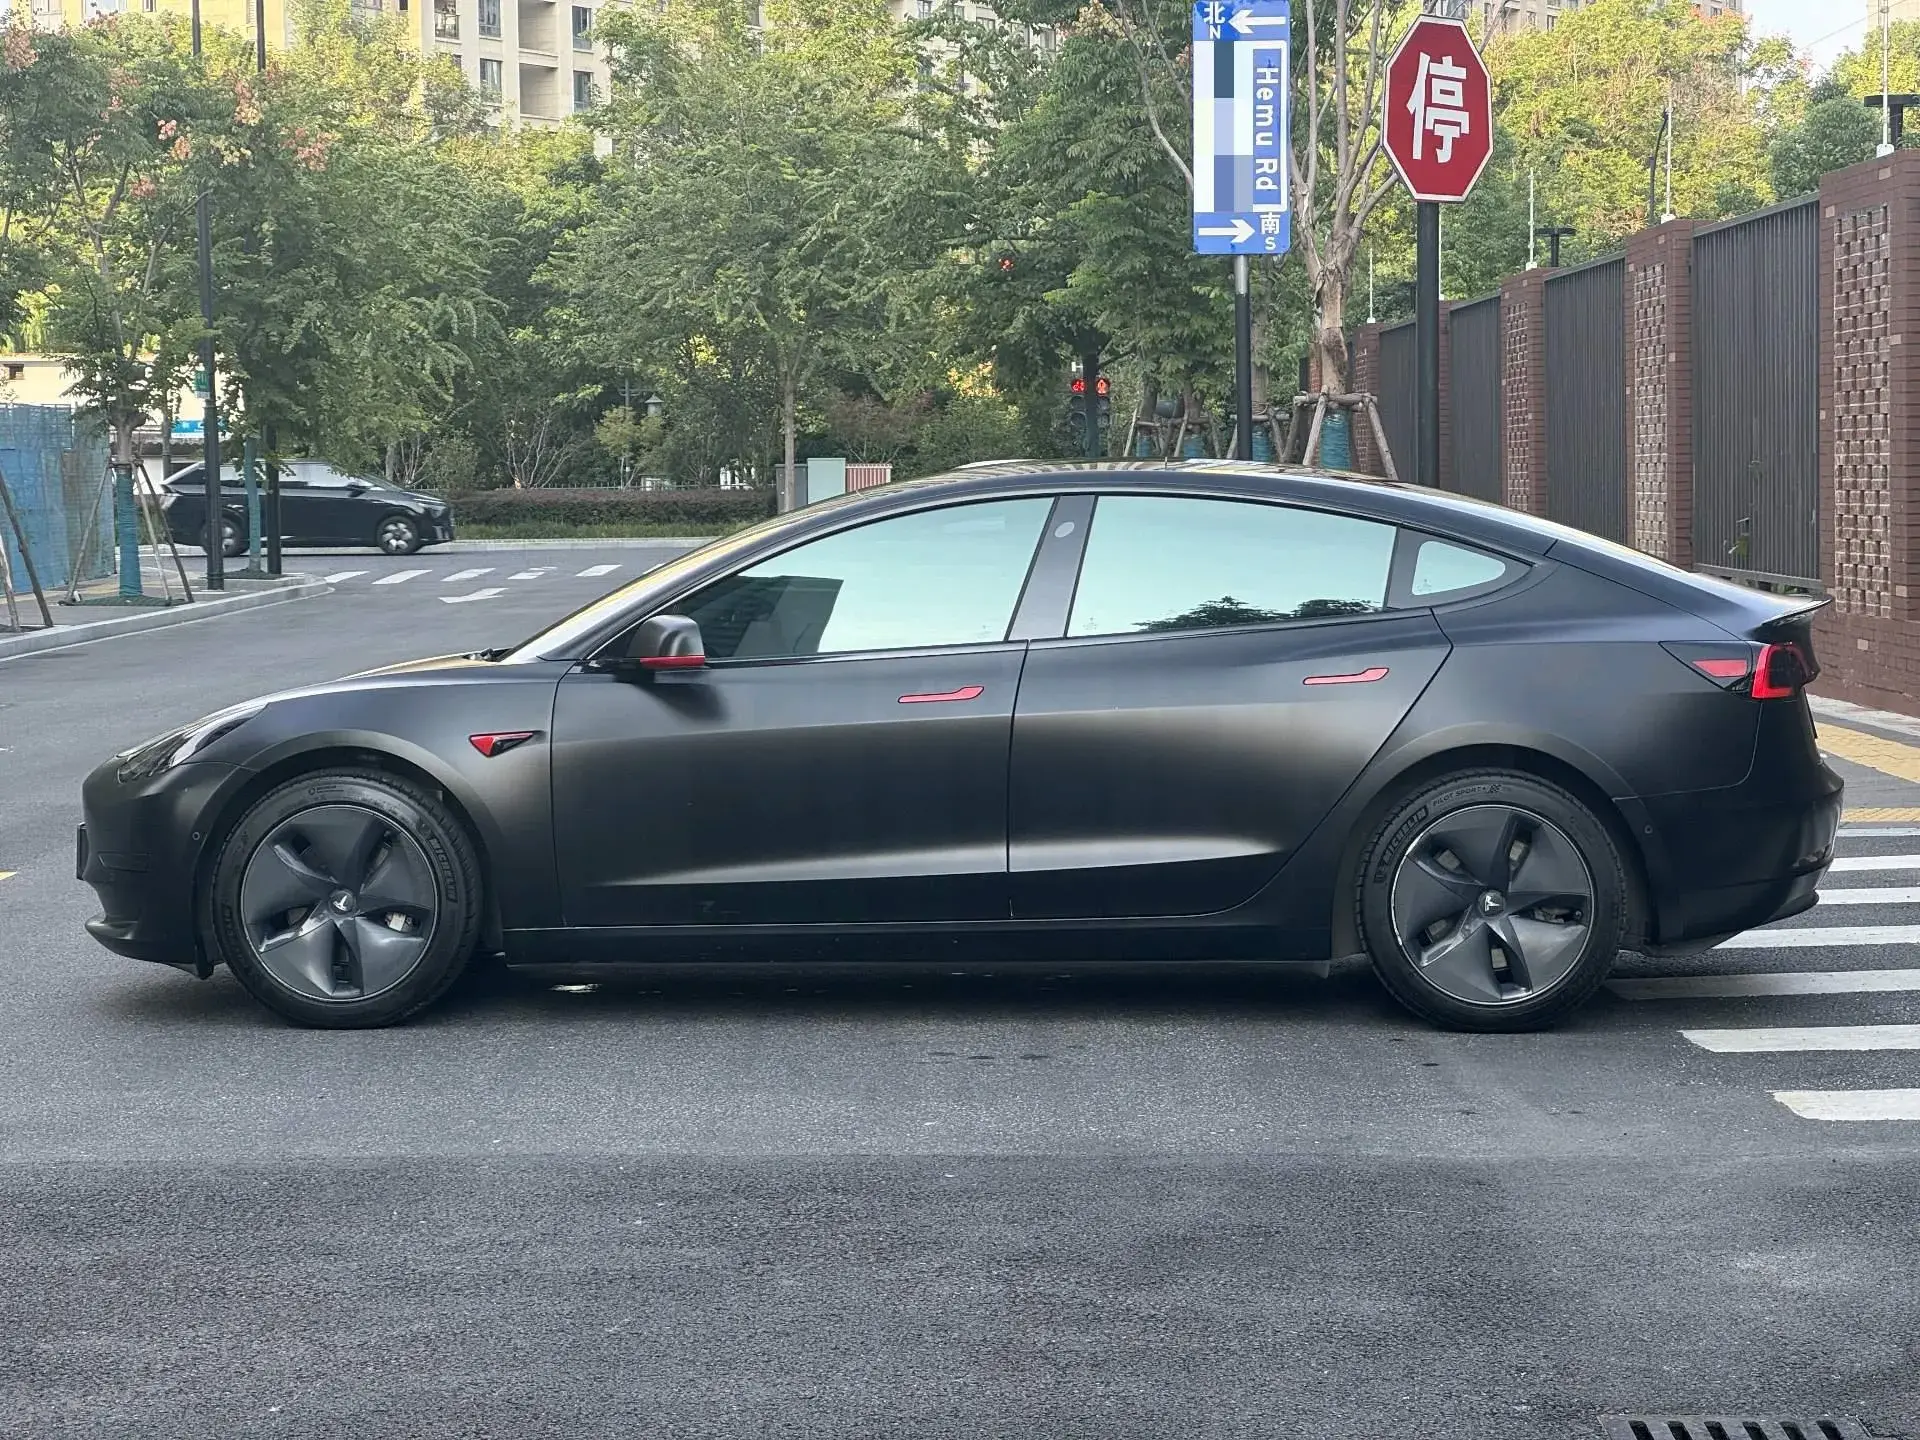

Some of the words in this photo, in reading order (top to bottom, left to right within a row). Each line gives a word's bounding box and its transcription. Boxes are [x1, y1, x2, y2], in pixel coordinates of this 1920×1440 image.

[1204, 3, 1226, 24] 北
[1209, 25, 1221, 39] N
[1256, 67, 1279, 146] Hemu
[1406, 51, 1470, 164] 停
[1256, 158, 1279, 190] Rd
[1260, 212, 1280, 234] 南
[1264, 236, 1276, 250] S
[1432, 793, 1454, 806] PILOT
[1455, 786, 1481, 797] SPORT
[1382, 806, 1428, 865] MICHELIN
